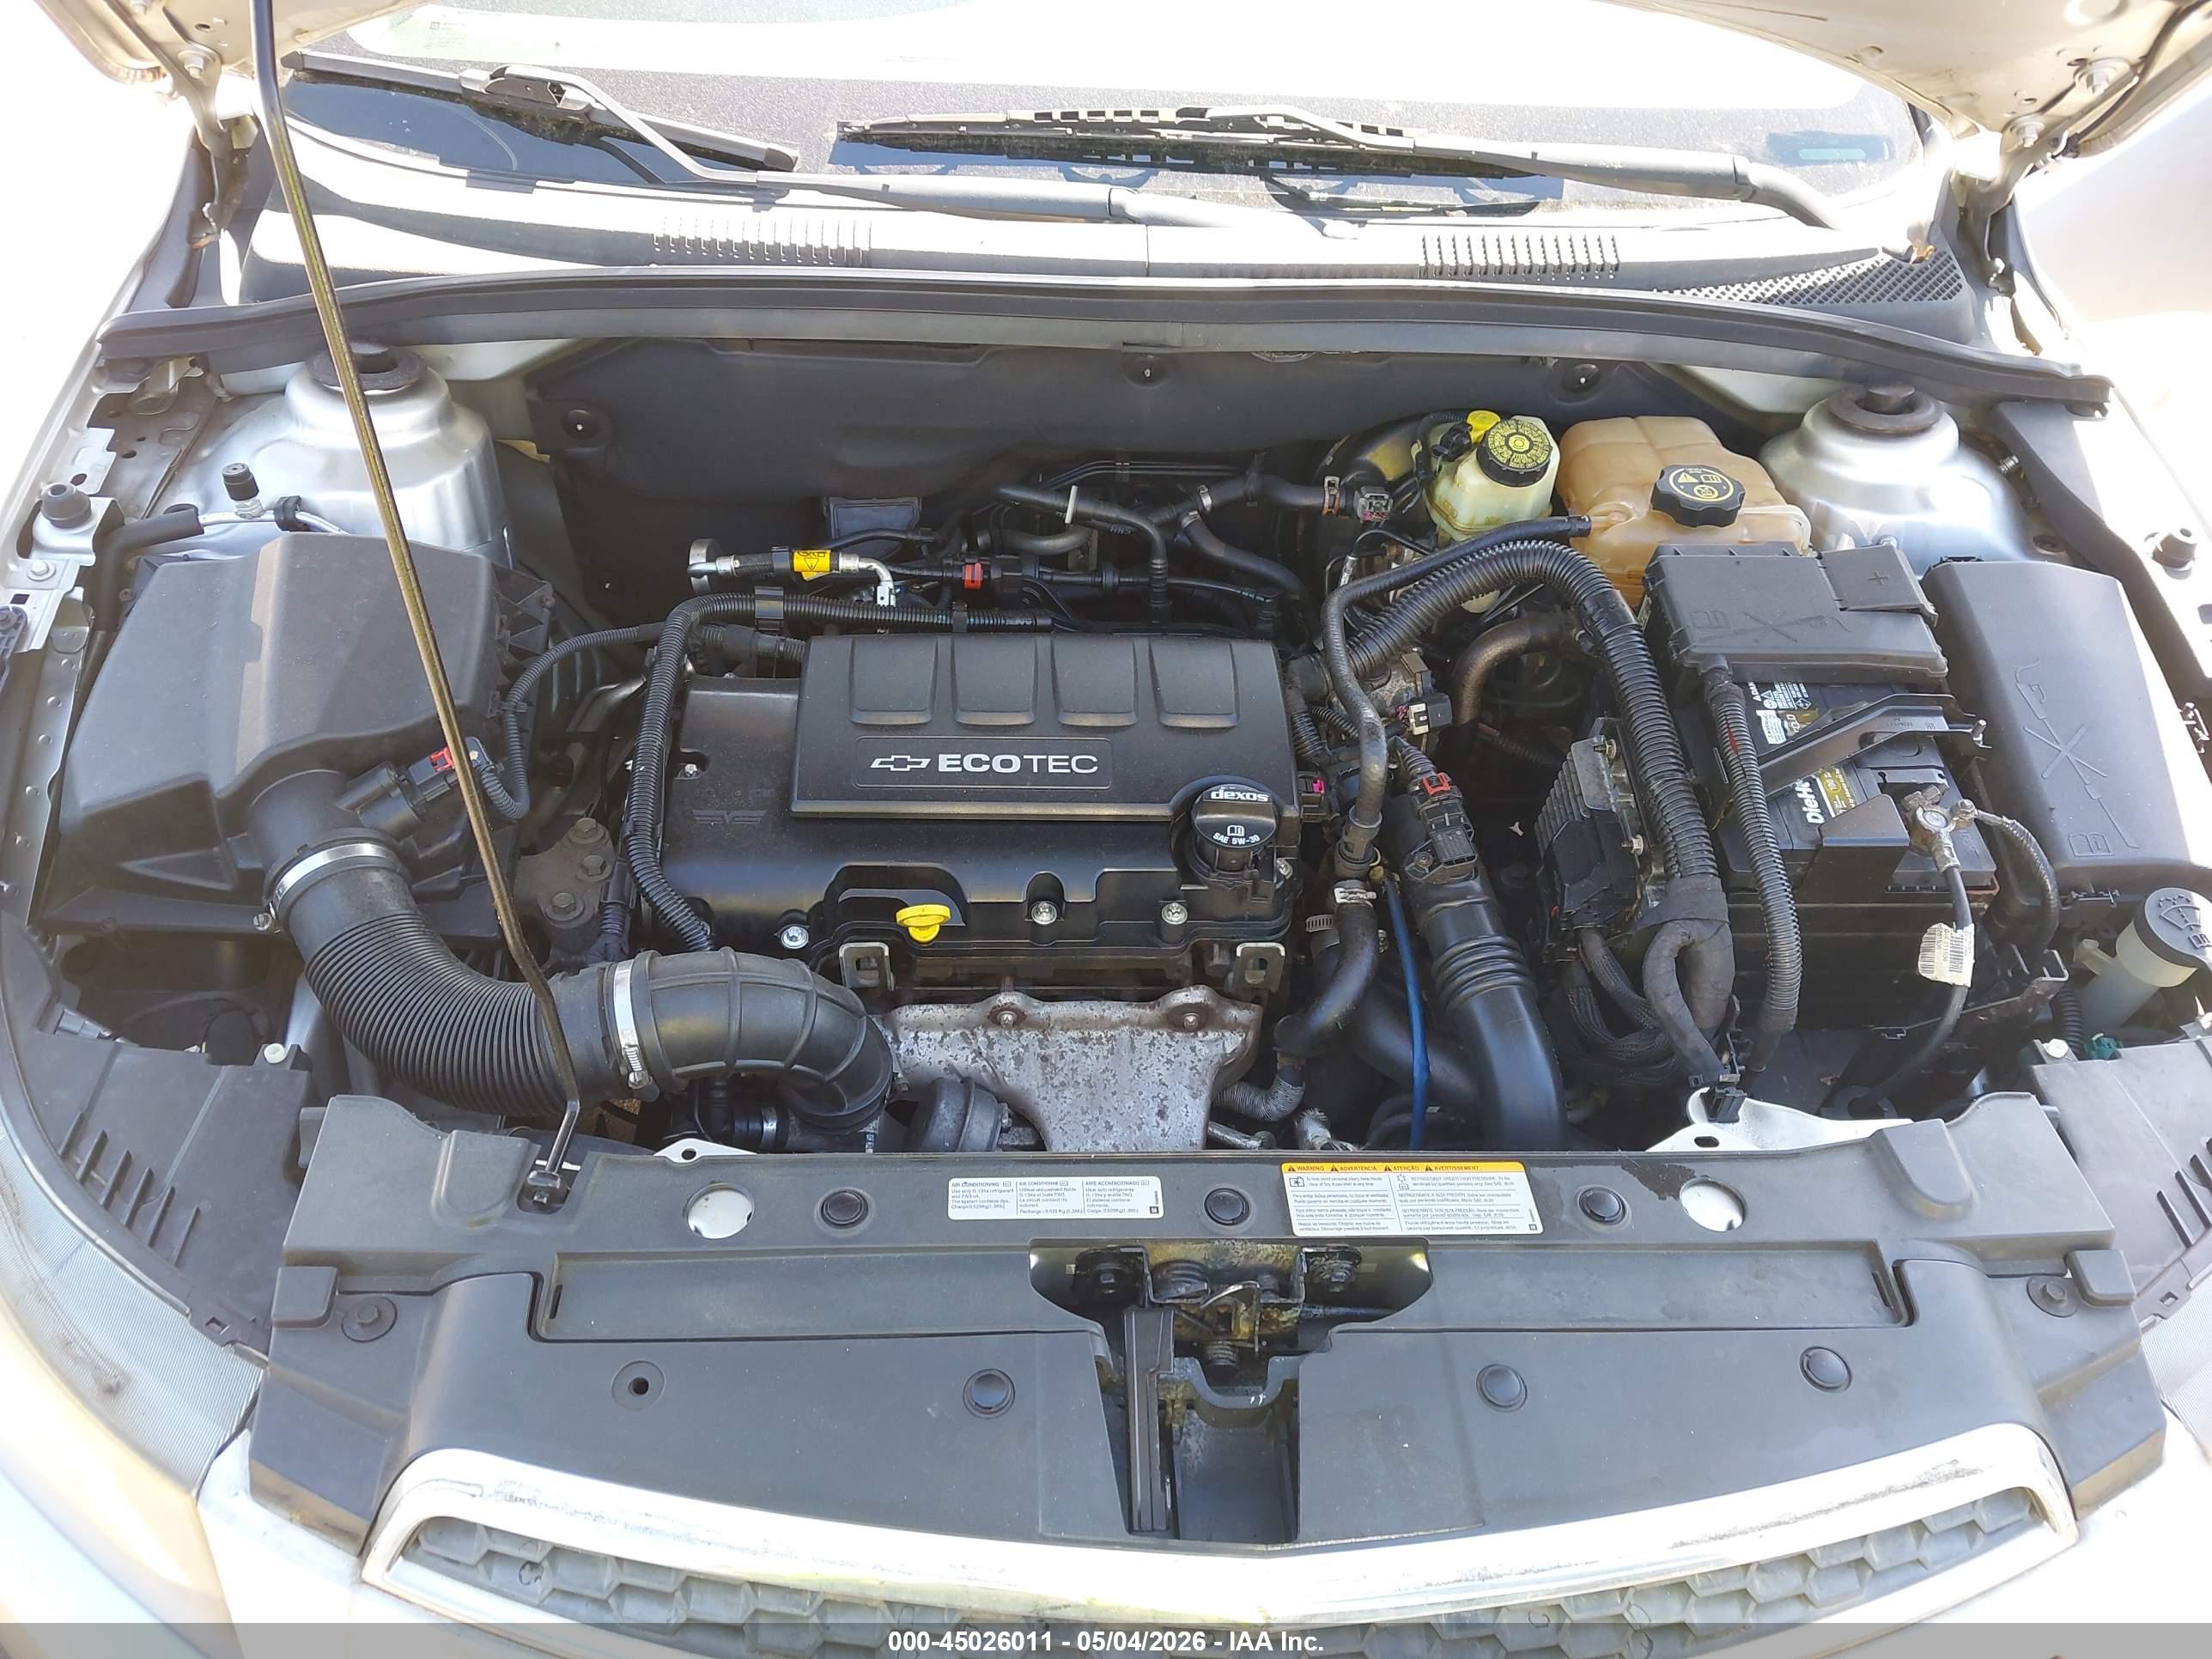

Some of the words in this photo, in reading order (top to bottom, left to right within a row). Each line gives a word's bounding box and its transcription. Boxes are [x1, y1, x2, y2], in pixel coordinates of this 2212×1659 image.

[938, 753, 1099, 774] ECOTEC
[1211, 788, 1270, 802] dexos
[1212, 832, 1230, 844] SAE
[1231, 834, 1261, 845] 5W-30
